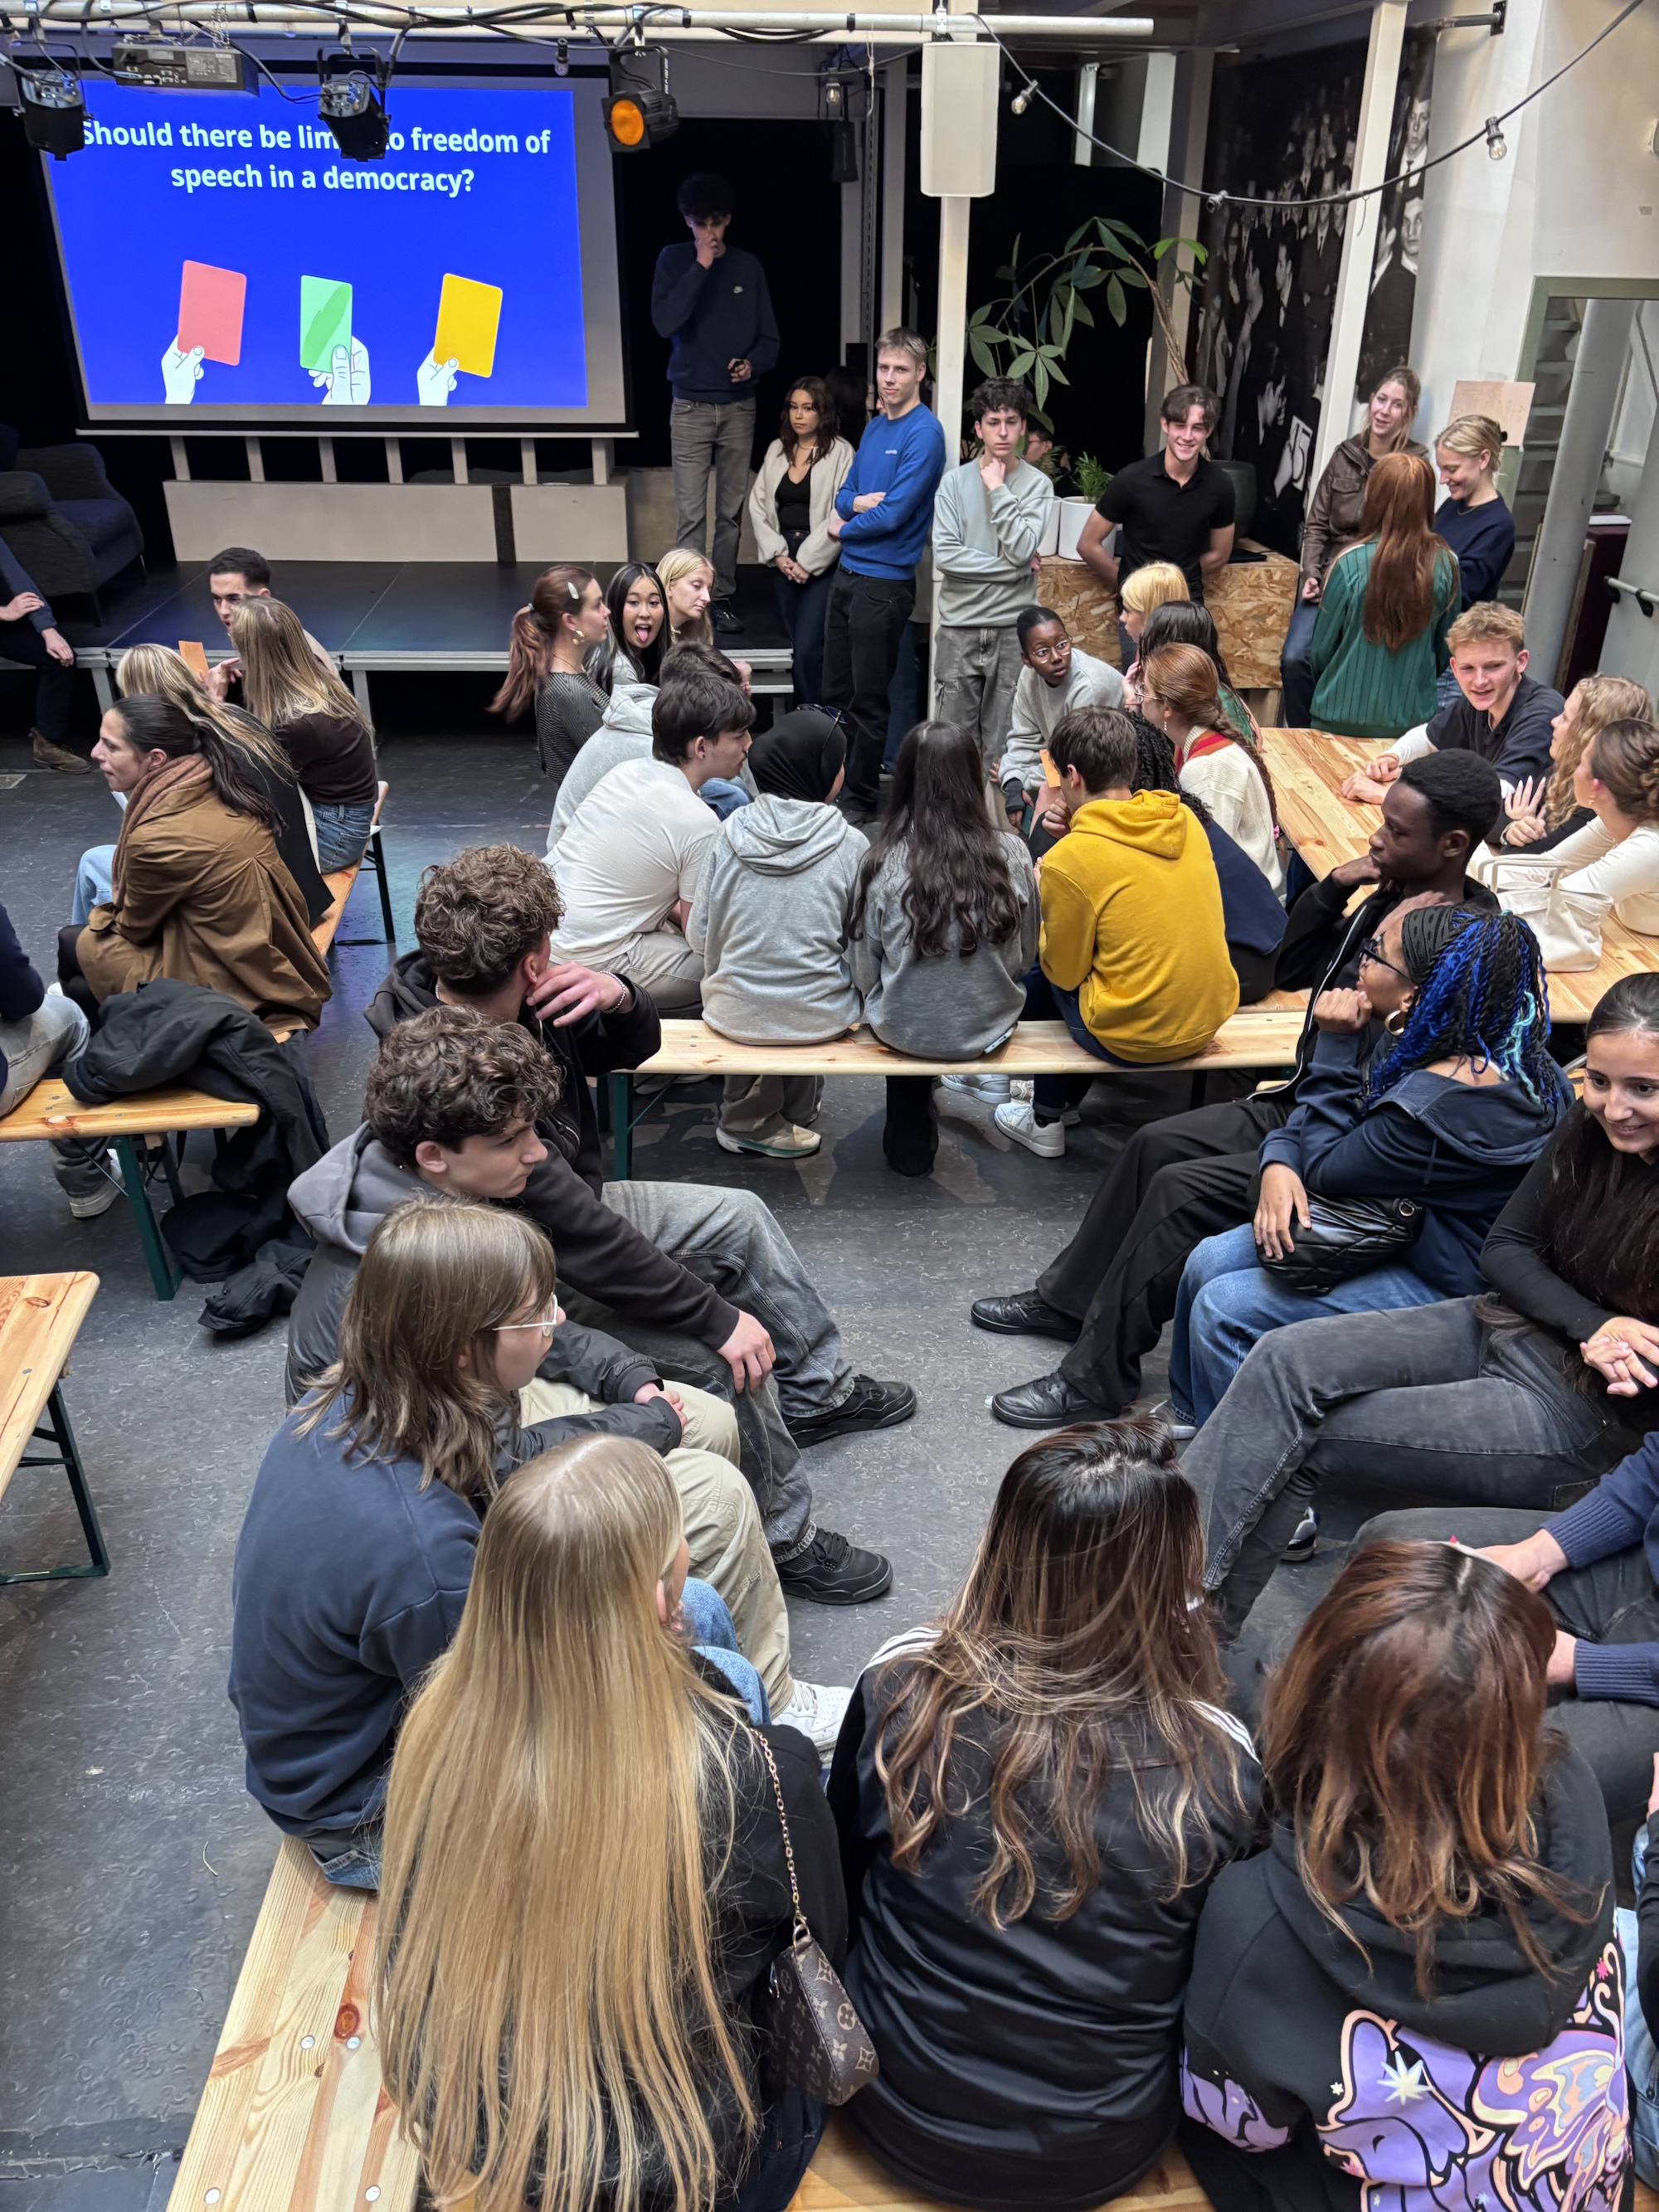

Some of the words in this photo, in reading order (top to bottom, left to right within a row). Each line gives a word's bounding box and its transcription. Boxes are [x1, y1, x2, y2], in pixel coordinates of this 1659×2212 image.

[82, 120, 173, 146] Should
[178, 123, 253, 148] there
[259, 124, 292, 148] be
[298, 125, 340, 149] lim
[385, 132, 405, 151] o
[411, 127, 518, 153] freedom
[525, 129, 552, 154] of
[170, 163, 263, 194] speech
[269, 164, 294, 188] in
[301, 170, 317, 189] a
[323, 165, 475, 198] democracy?
